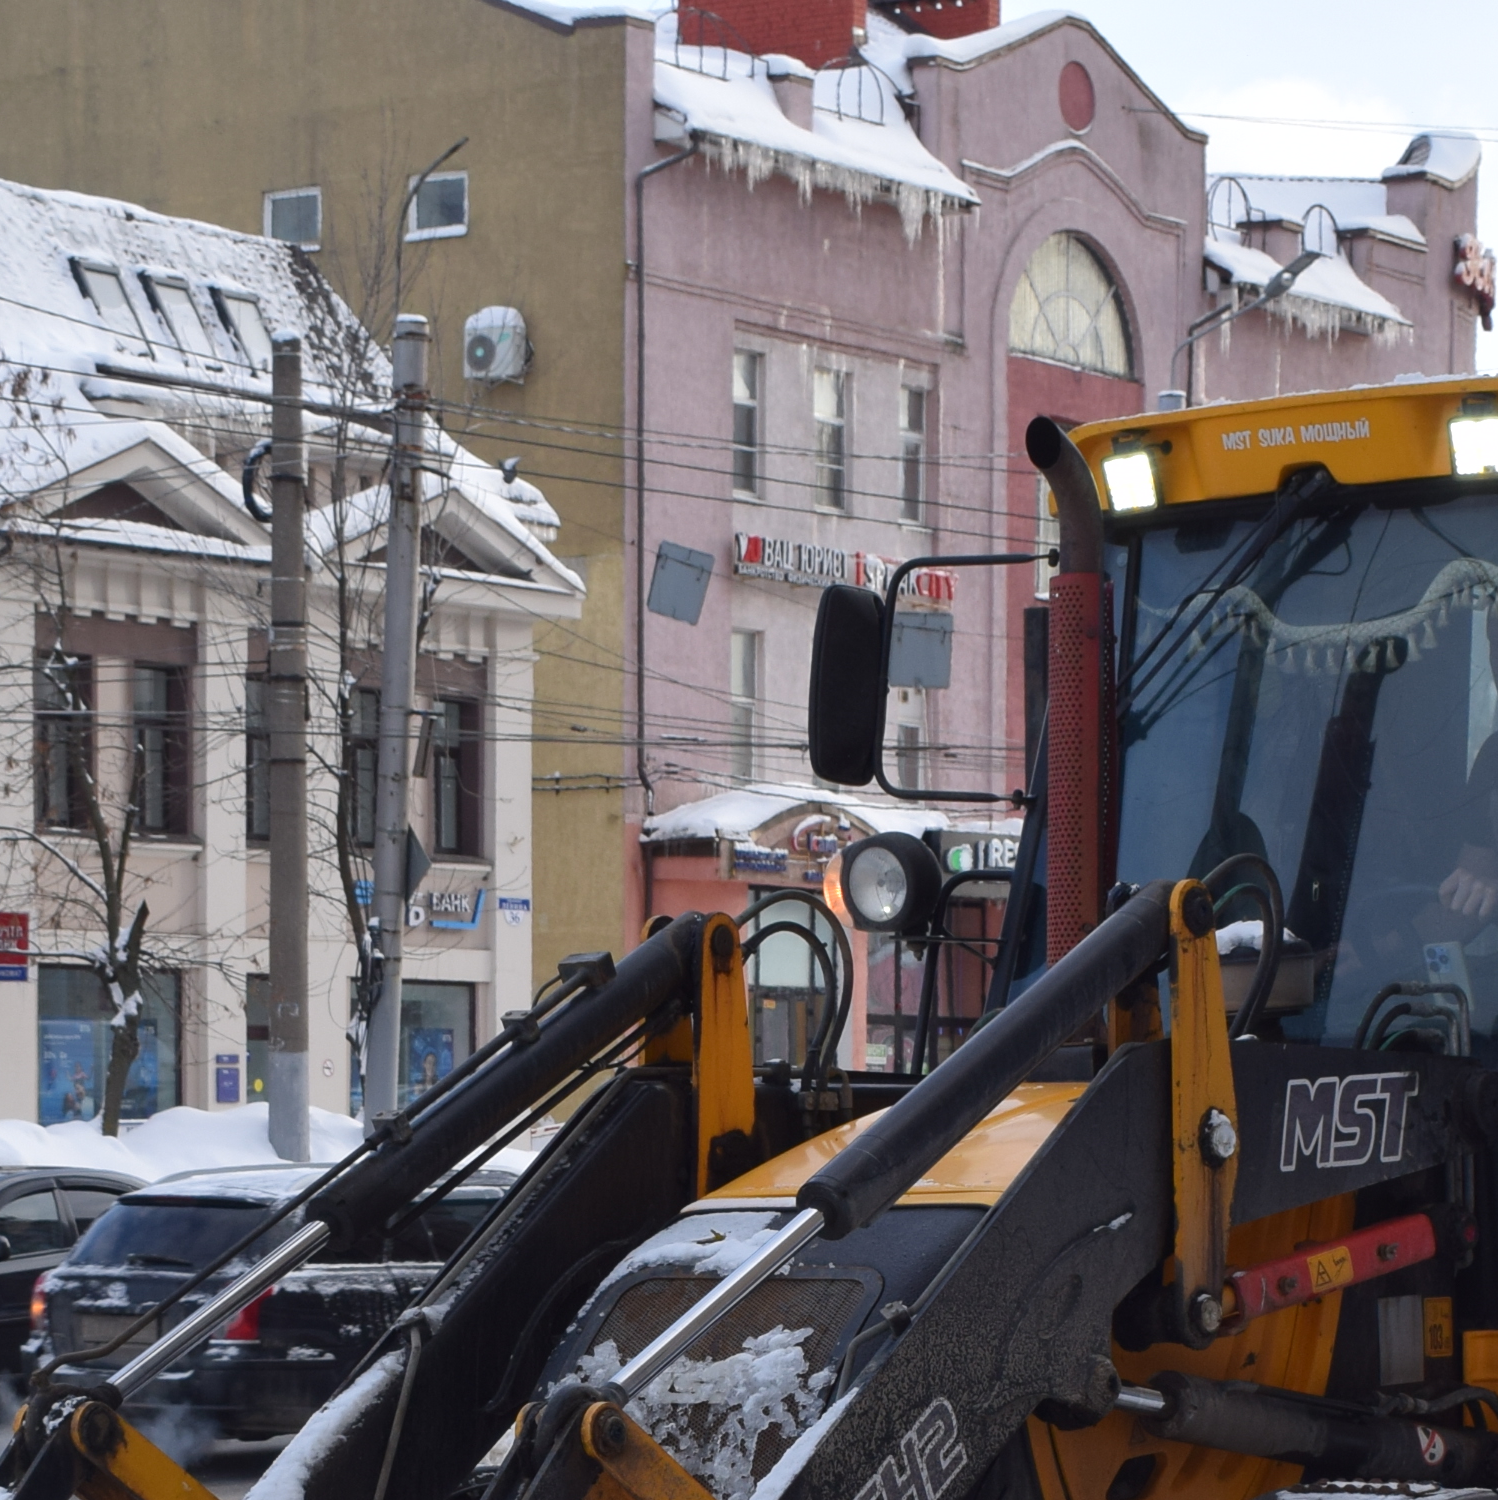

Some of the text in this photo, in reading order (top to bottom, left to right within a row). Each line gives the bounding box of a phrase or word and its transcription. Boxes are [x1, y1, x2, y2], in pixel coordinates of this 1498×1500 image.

[1222, 417, 1370, 450] MST SUKA МОЩНЫЙ
[431, 892, 471, 913] БАНК
[1280, 1071, 1419, 1172] MST
